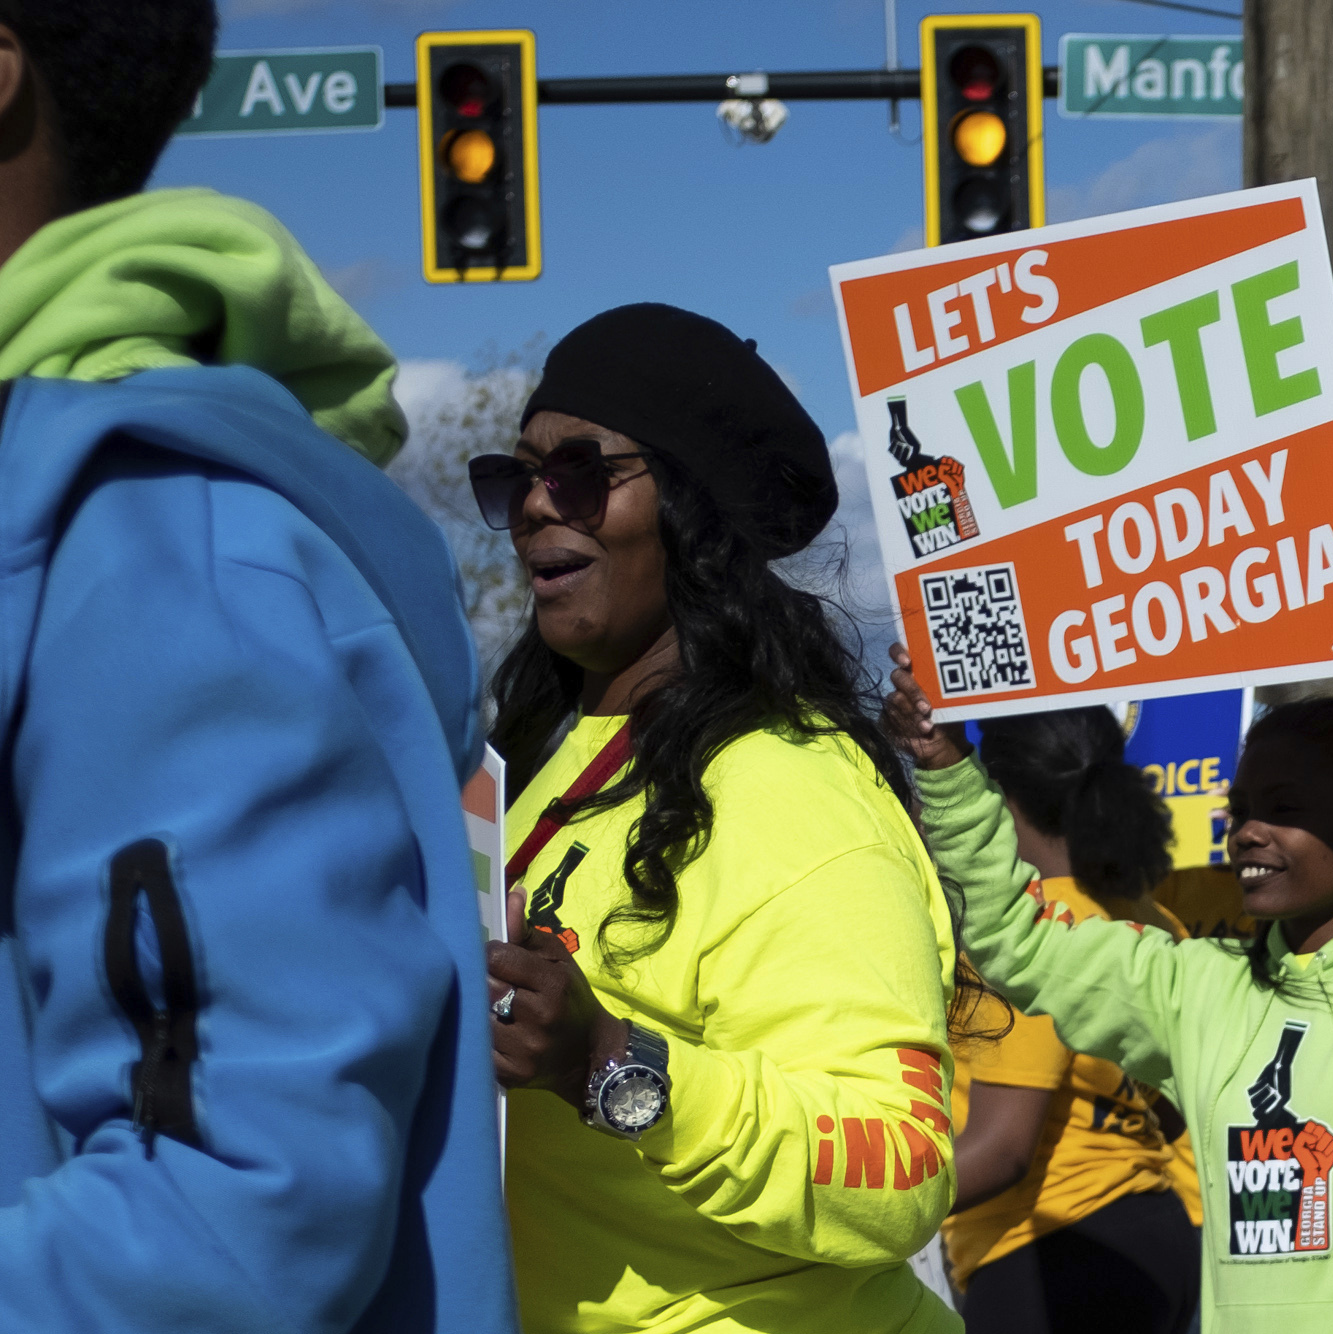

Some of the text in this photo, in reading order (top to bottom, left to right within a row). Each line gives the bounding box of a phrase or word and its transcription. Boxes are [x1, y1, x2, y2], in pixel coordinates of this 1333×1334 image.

[239, 60, 358, 117] Ave
[893, 249, 1059, 373] LET'S
[954, 260, 1322, 510] VOTE
[897, 482, 951, 519] VOTE
[898, 464, 938, 495] we
[911, 503, 951, 533] we
[1064, 448, 1288, 589] TODAY
[1240, 1128, 1294, 1162] we
[1241, 1189, 1293, 1221] we
[1300, 1185, 1314, 1247] GEORGIA
